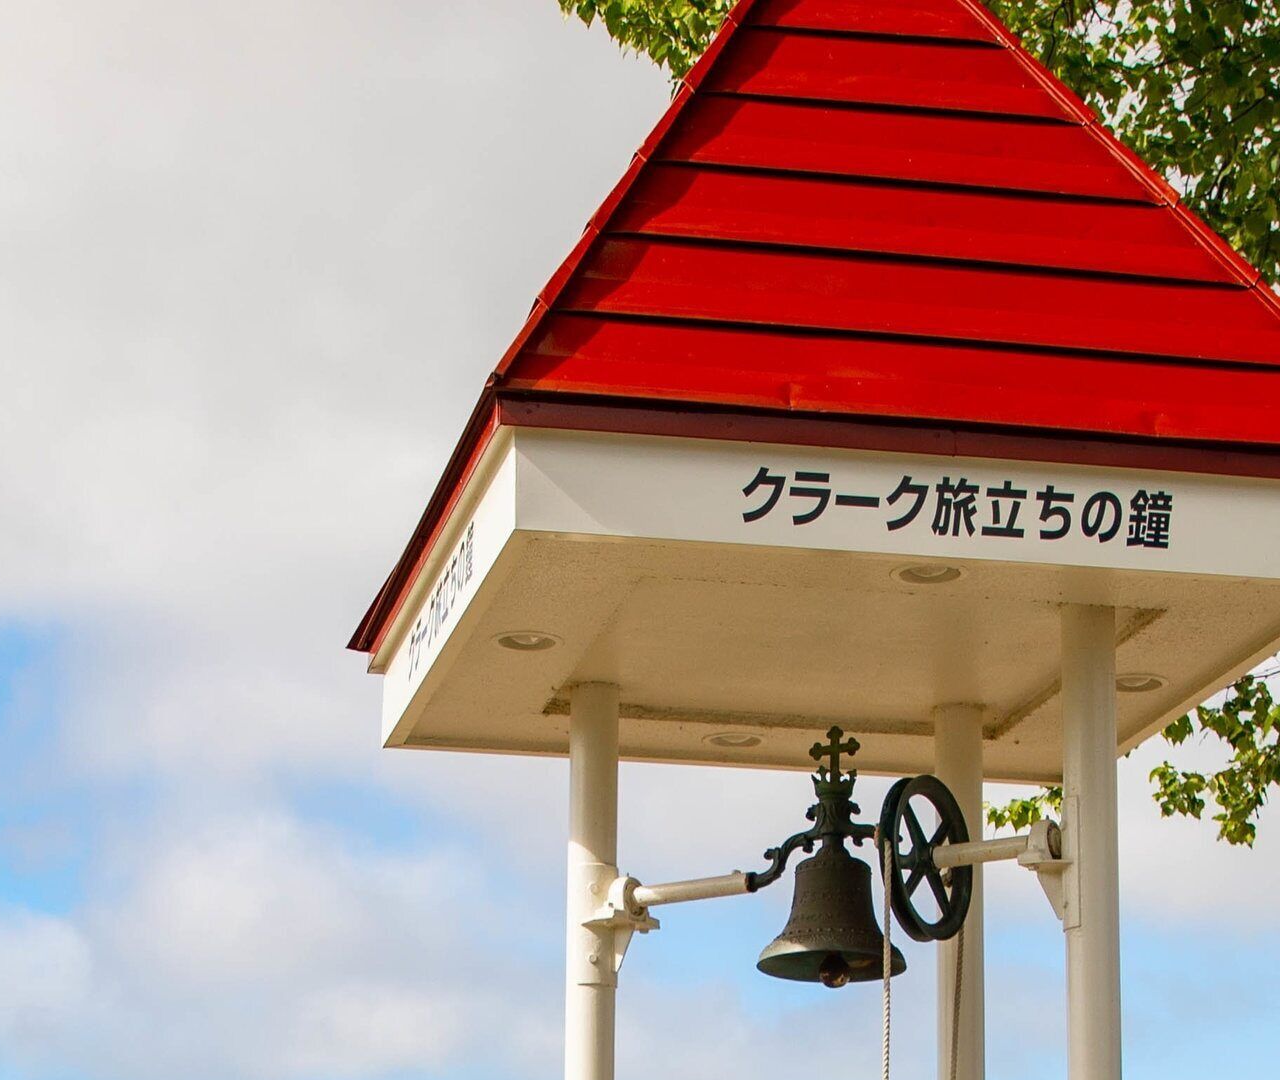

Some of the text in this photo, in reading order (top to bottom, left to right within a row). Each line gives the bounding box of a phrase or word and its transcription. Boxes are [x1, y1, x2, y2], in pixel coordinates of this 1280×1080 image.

[741, 466, 1174, 550] クラーク旅立ちの鐘
